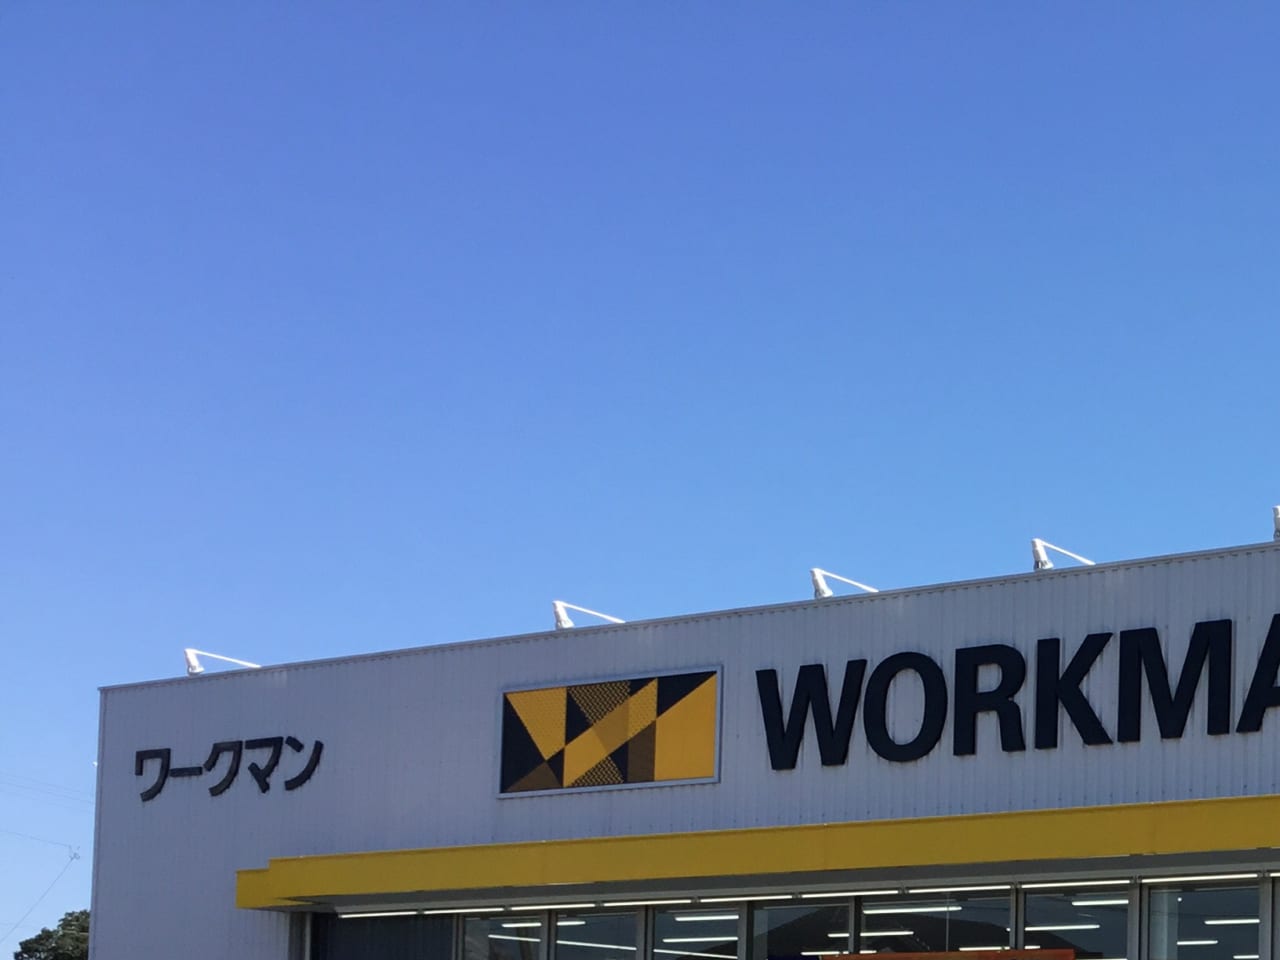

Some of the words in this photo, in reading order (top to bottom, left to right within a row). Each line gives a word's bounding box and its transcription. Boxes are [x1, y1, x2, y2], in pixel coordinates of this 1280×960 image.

[135, 736, 324, 802] ワークマン
